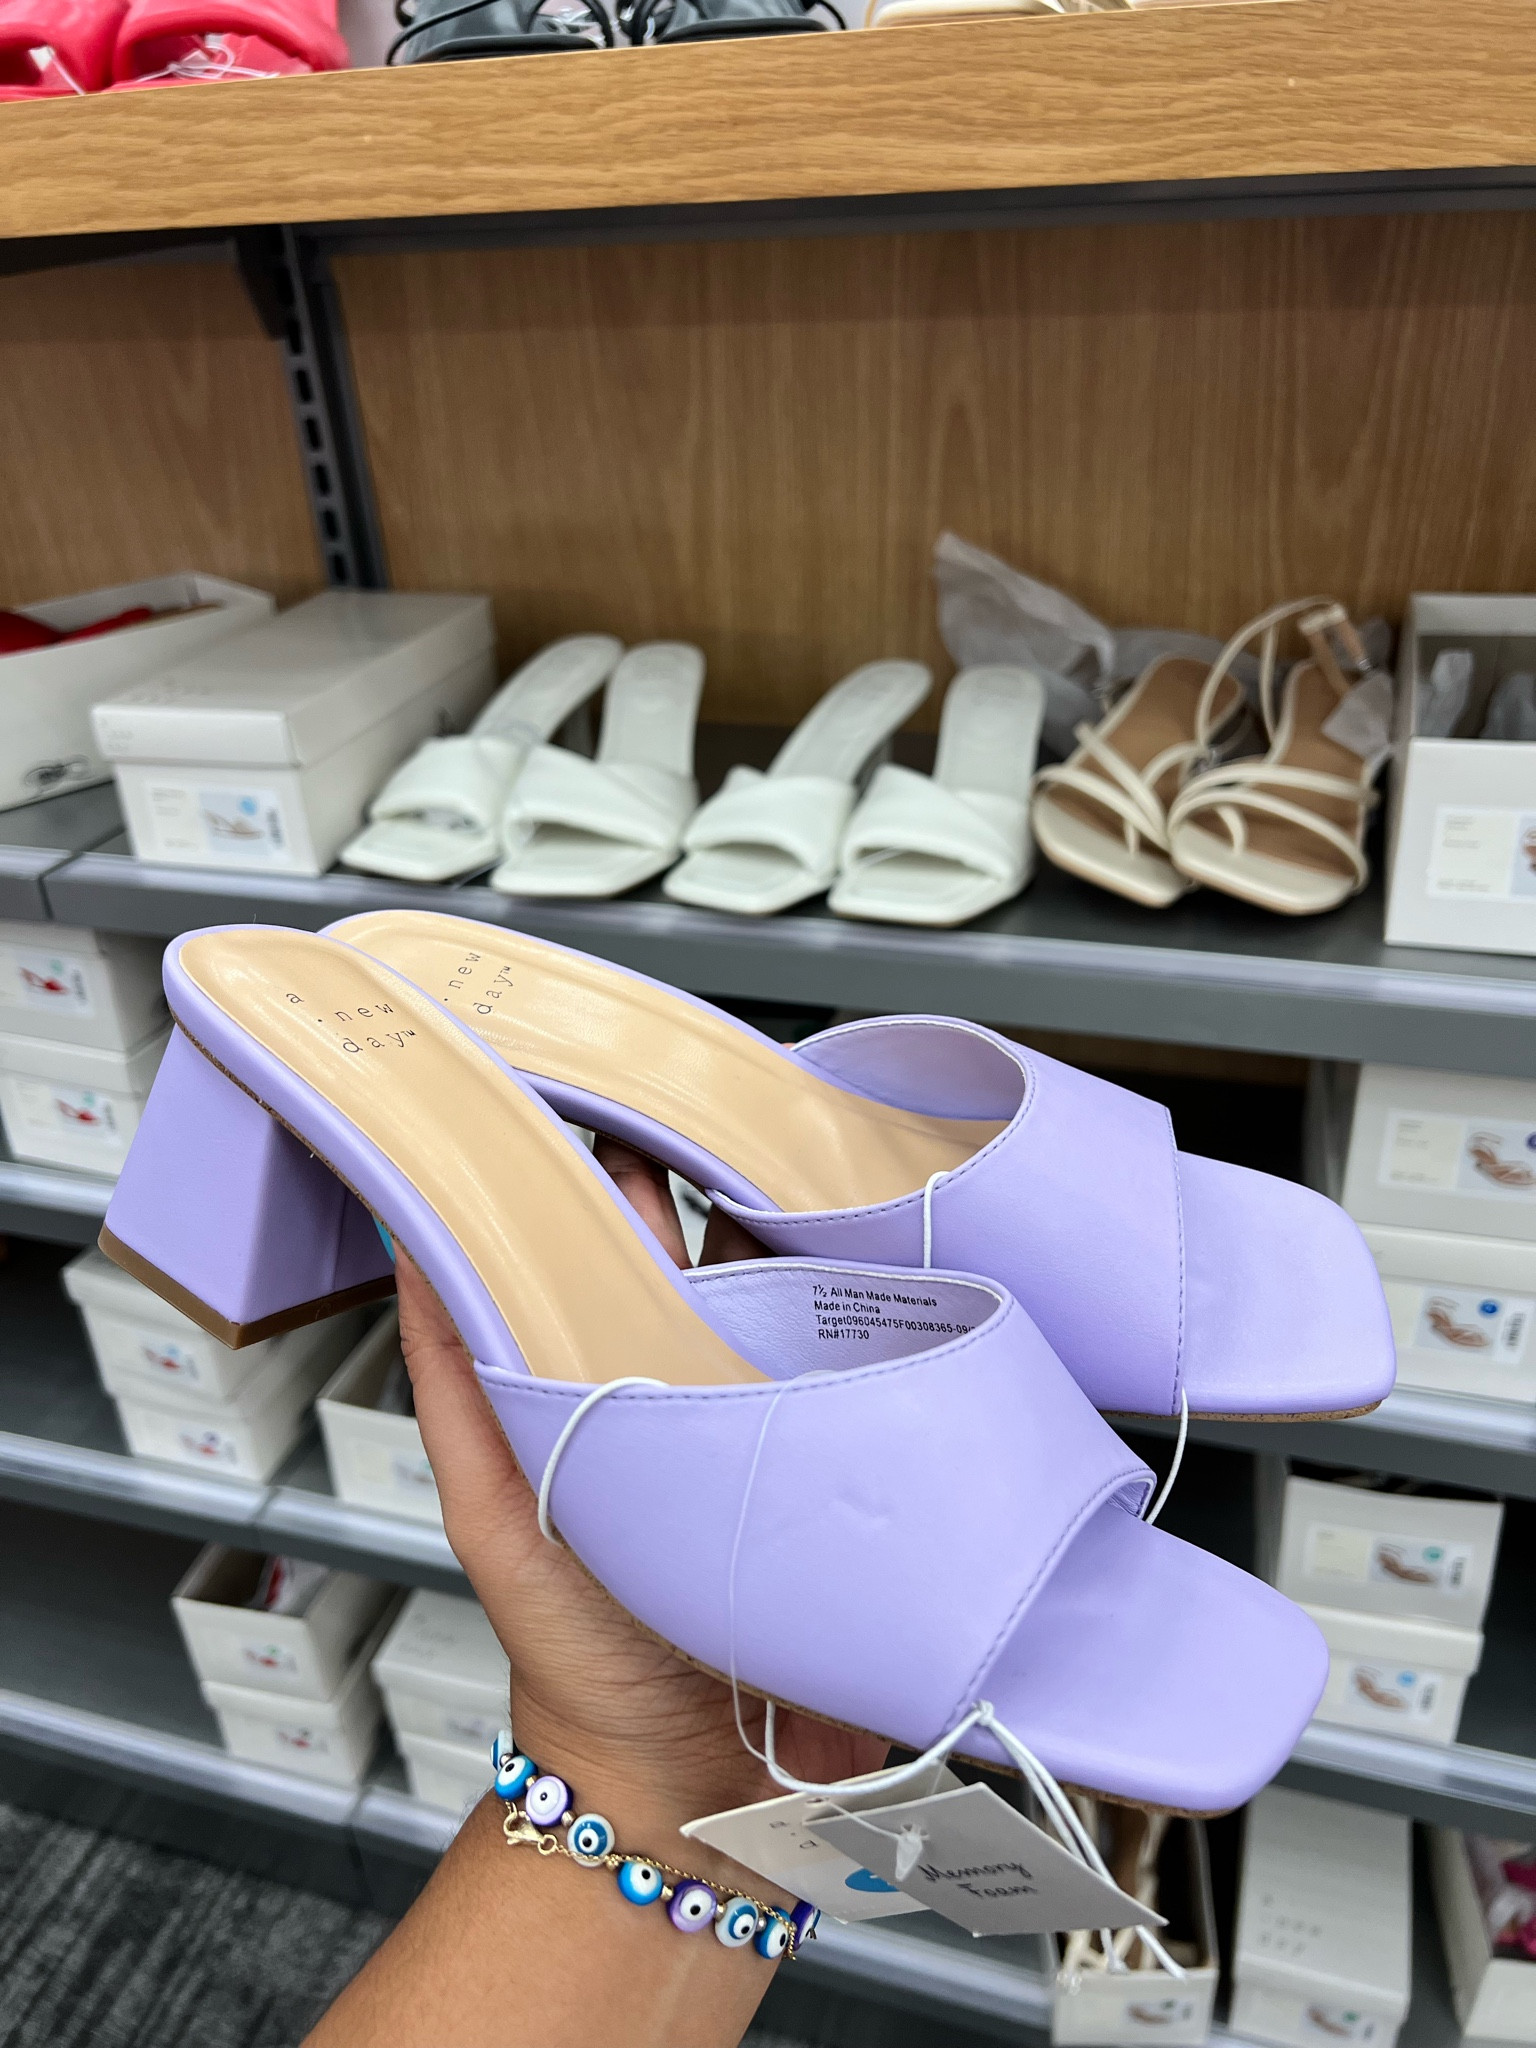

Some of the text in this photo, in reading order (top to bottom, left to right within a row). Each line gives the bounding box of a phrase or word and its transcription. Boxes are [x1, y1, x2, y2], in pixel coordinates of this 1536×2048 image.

[830, 1286, 843, 1297] All
[844, 1287, 865, 1299] Man
[865, 1290, 892, 1302] Made
[892, 1293, 938, 1307] Materials
[814, 1300, 881, 1314] Made in China
[818, 1328, 870, 1340] RN#17730
[917, 1862, 1034, 1884] Memory
[956, 1882, 1039, 1898] Foam
